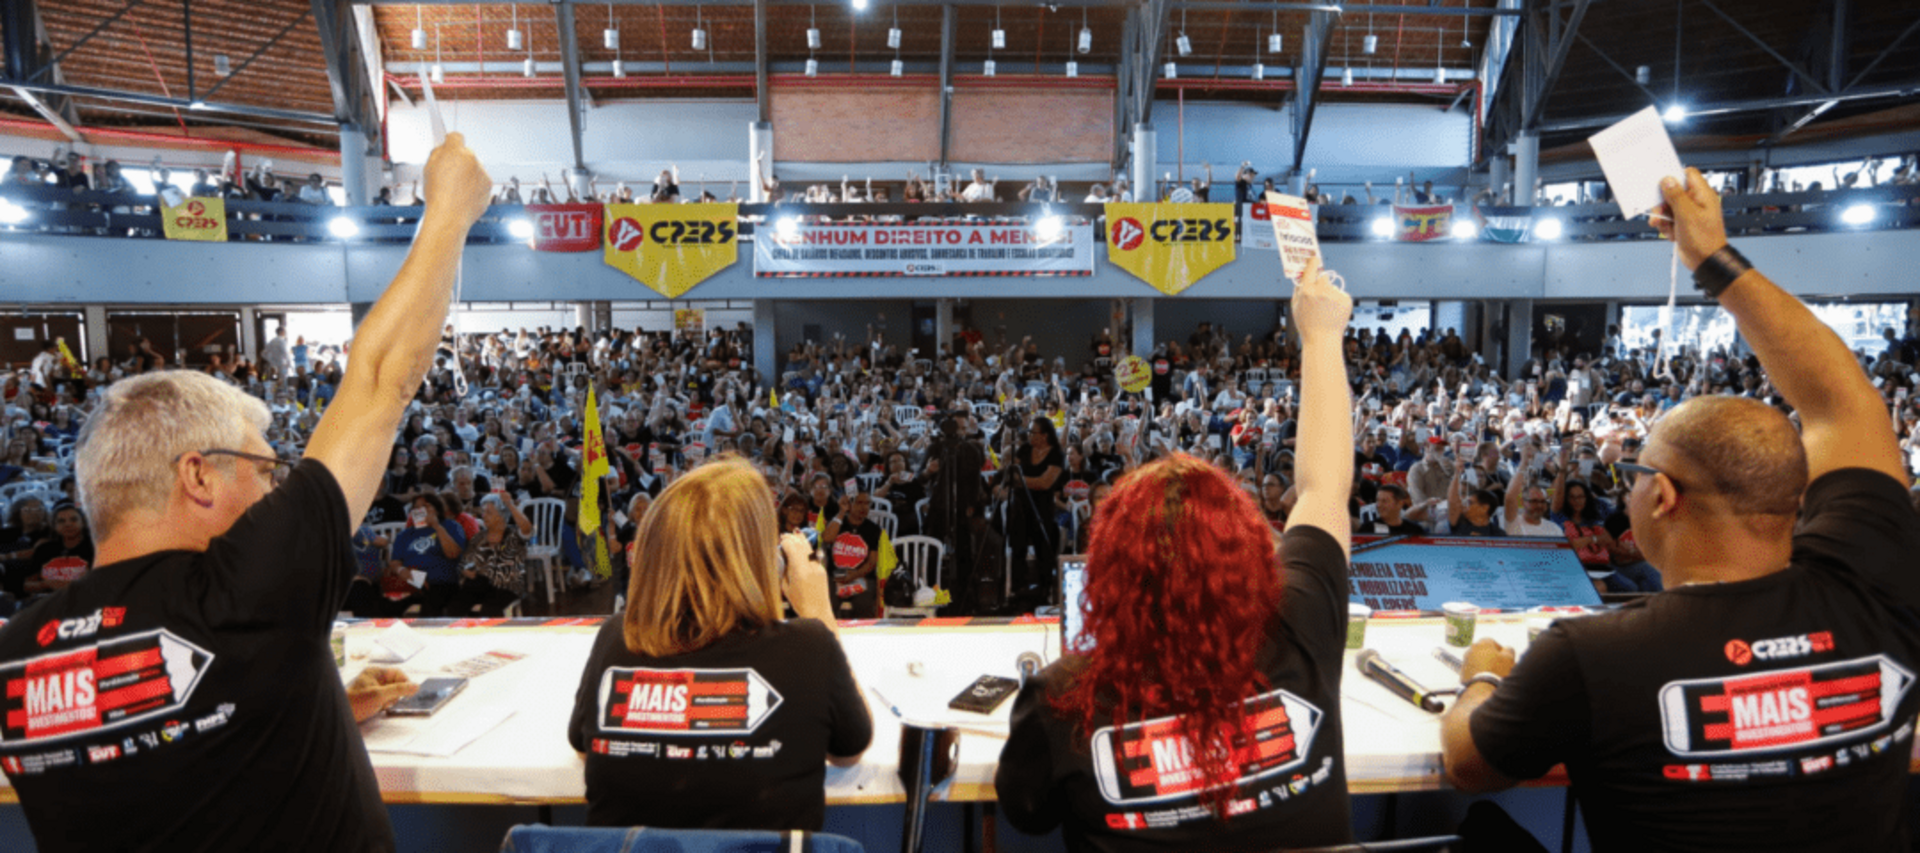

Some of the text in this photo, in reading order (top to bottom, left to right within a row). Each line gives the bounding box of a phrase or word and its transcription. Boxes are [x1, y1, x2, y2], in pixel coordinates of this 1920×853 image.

[538, 212, 587, 239] CUT
[650, 220, 735, 244] CPERS
[773, 230, 868, 245] ENHUM
[874, 230, 962, 245] DIREITO
[968, 230, 984, 244] A
[1150, 219, 1231, 242] CPERS
[1394, 562, 1428, 579] GERAL
[1751, 634, 1812, 661] CPERS
[26, 668, 97, 716] MAIS
[629, 683, 689, 712] MAIS
[1731, 687, 1812, 729] MAIS
